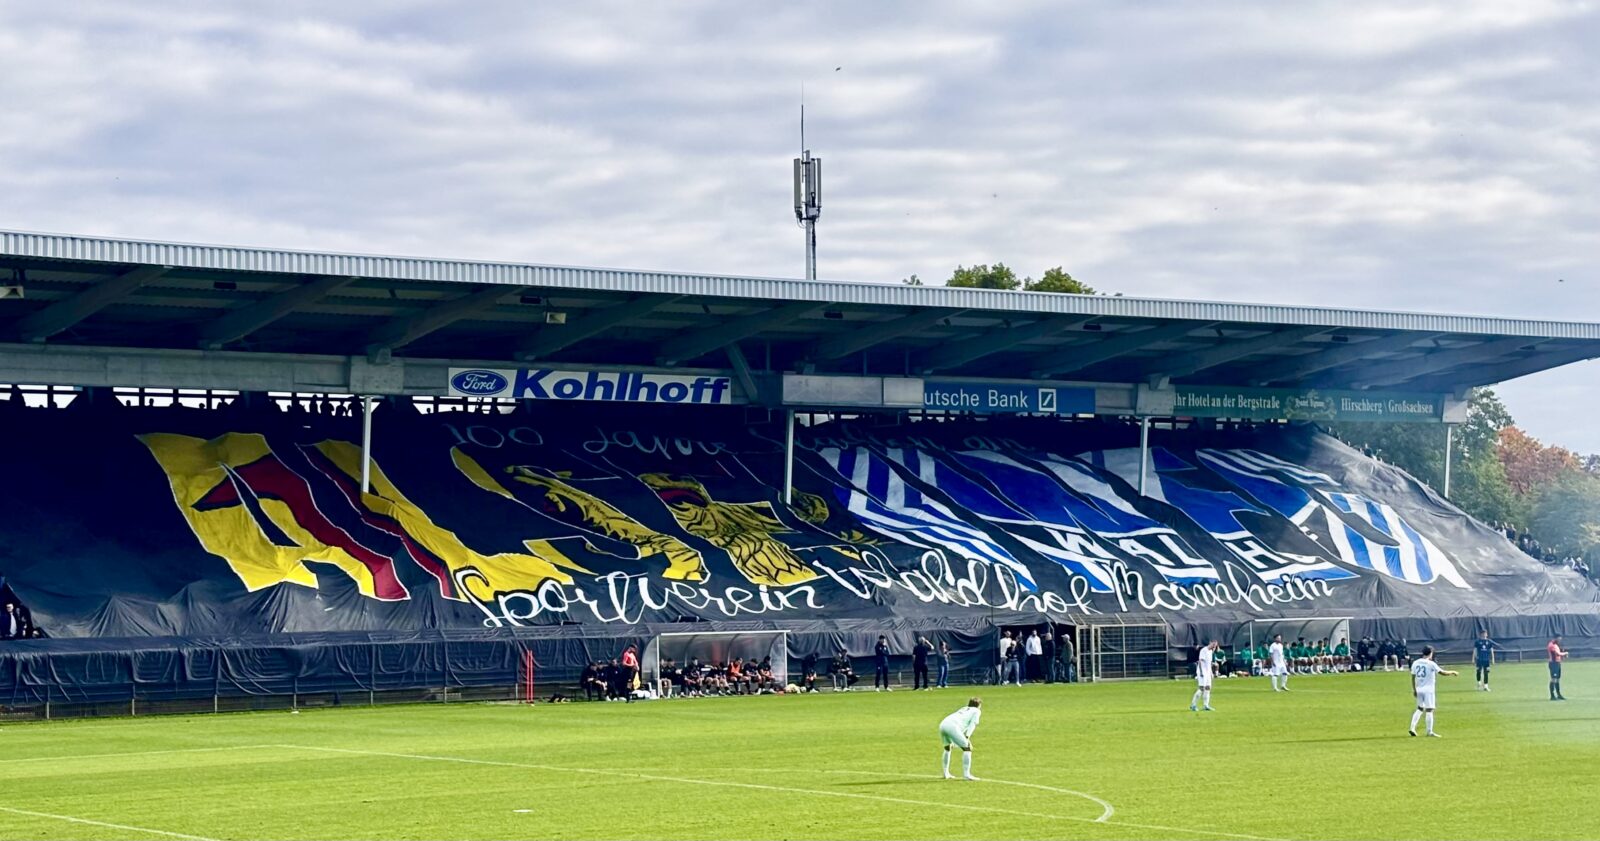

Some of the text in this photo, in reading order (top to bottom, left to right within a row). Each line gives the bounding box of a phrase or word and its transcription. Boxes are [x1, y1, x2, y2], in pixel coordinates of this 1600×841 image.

[462, 373, 496, 390] Ford
[512, 369, 729, 403] Kohlhoff
[924, 388, 1028, 408] utsche Bank
[1174, 392, 1187, 406] Ihr
[1188, 392, 1210, 408] Hotel
[1211, 396, 1221, 408] an
[1222, 394, 1236, 408] der
[1237, 395, 1280, 411] Bergstraße
[1341, 398, 1383, 415] Hirschberg
[1388, 399, 1433, 414] Großsachsen
[440, 422, 543, 449] 100
[812, 549, 1102, 614] Waldhof
[1104, 559, 1336, 612] Mannheim
[1415, 665, 1427, 679] 23
